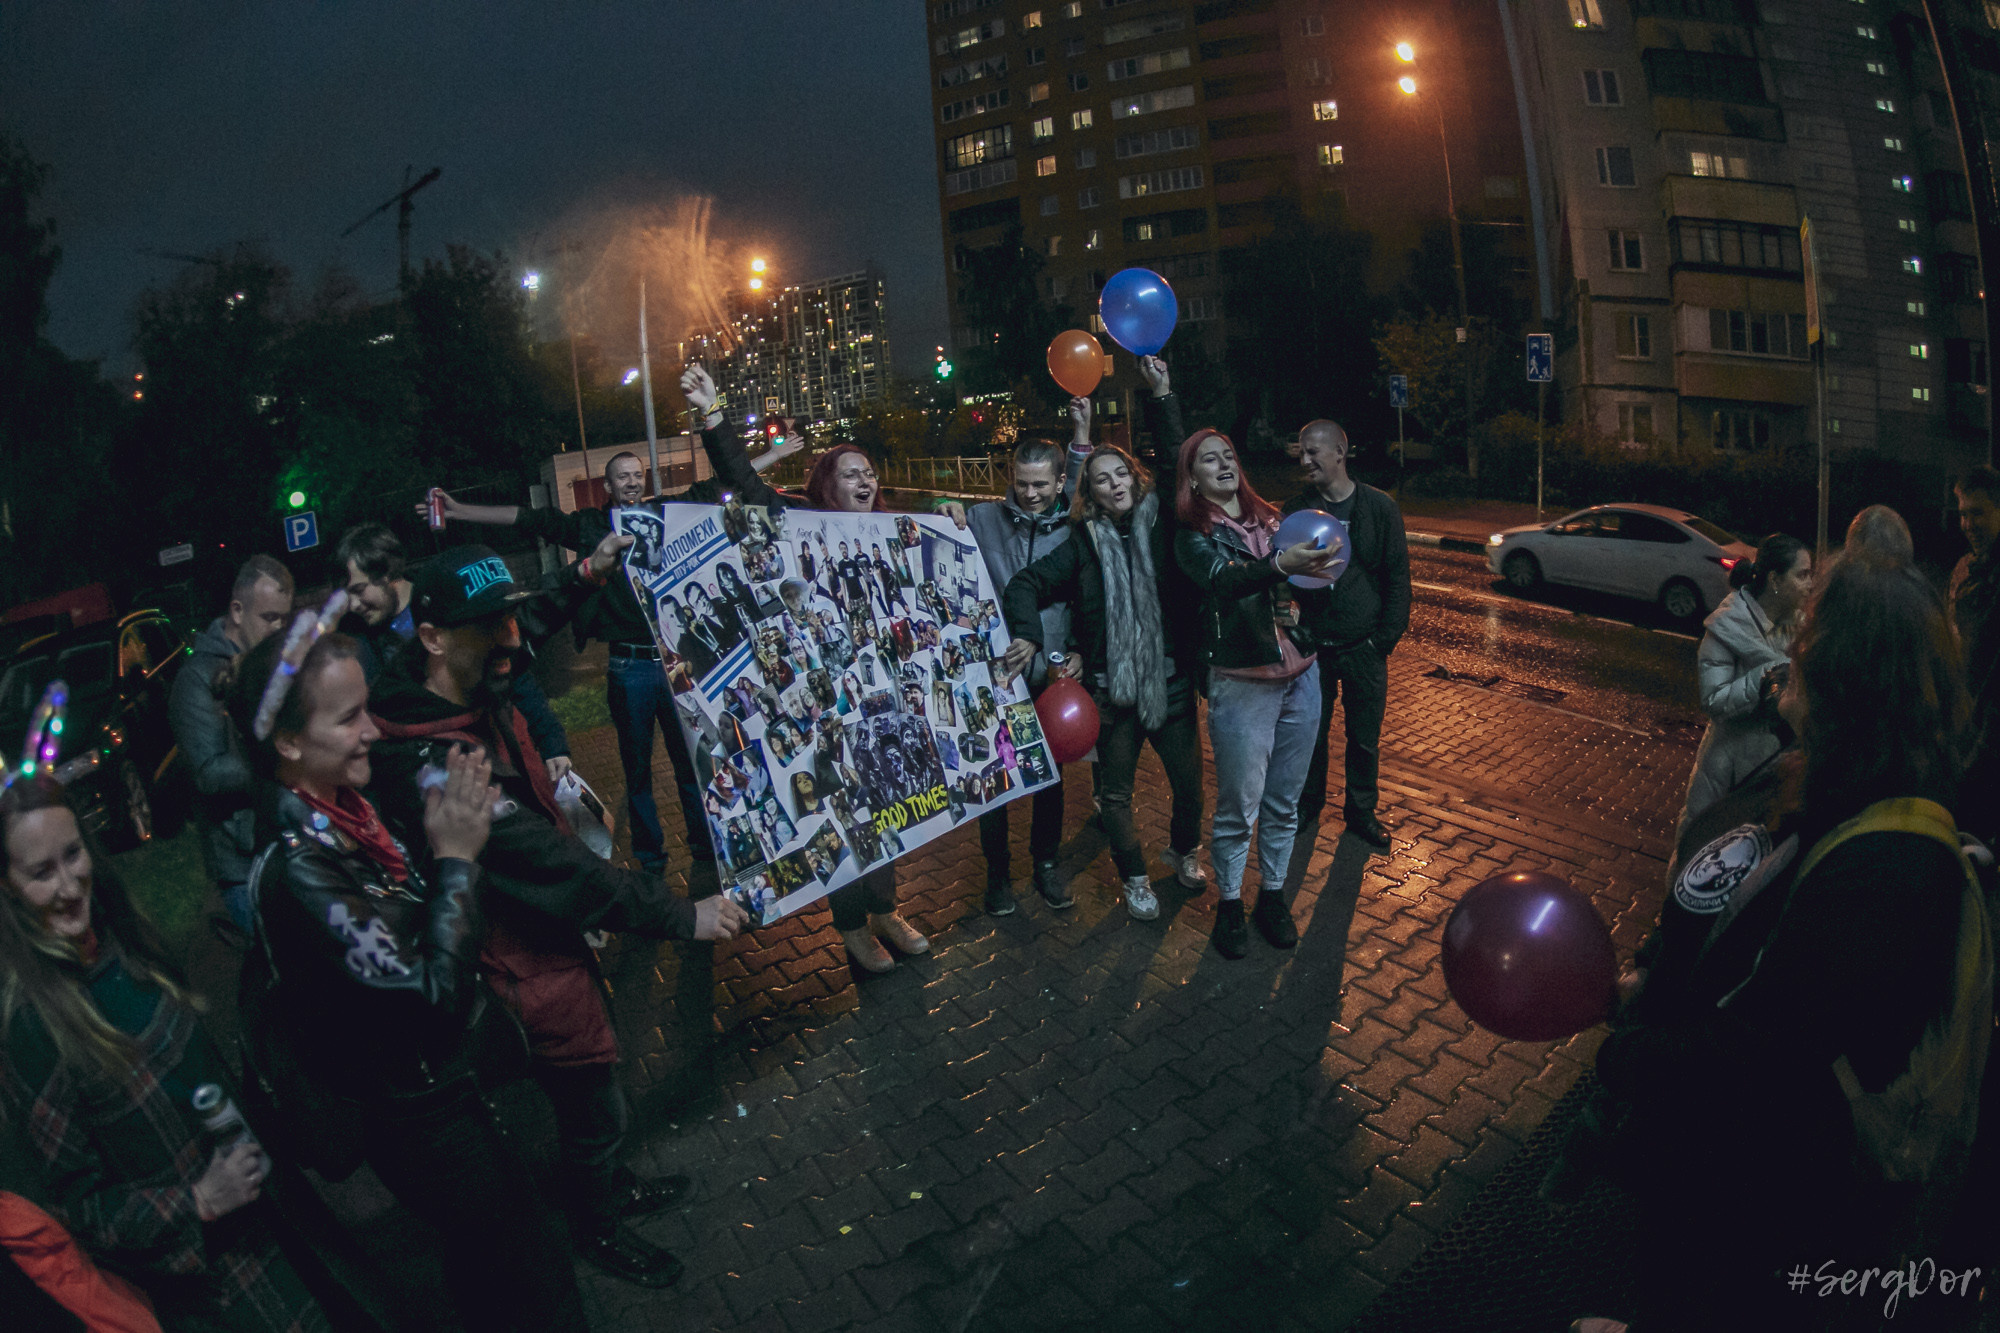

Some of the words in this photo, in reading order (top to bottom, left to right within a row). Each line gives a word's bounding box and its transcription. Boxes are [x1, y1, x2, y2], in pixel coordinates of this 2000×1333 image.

[291, 518, 310, 546] P
[636, 516, 718, 584] РАИОПОМЕХИ
[905, 783, 949, 822] TIMES
